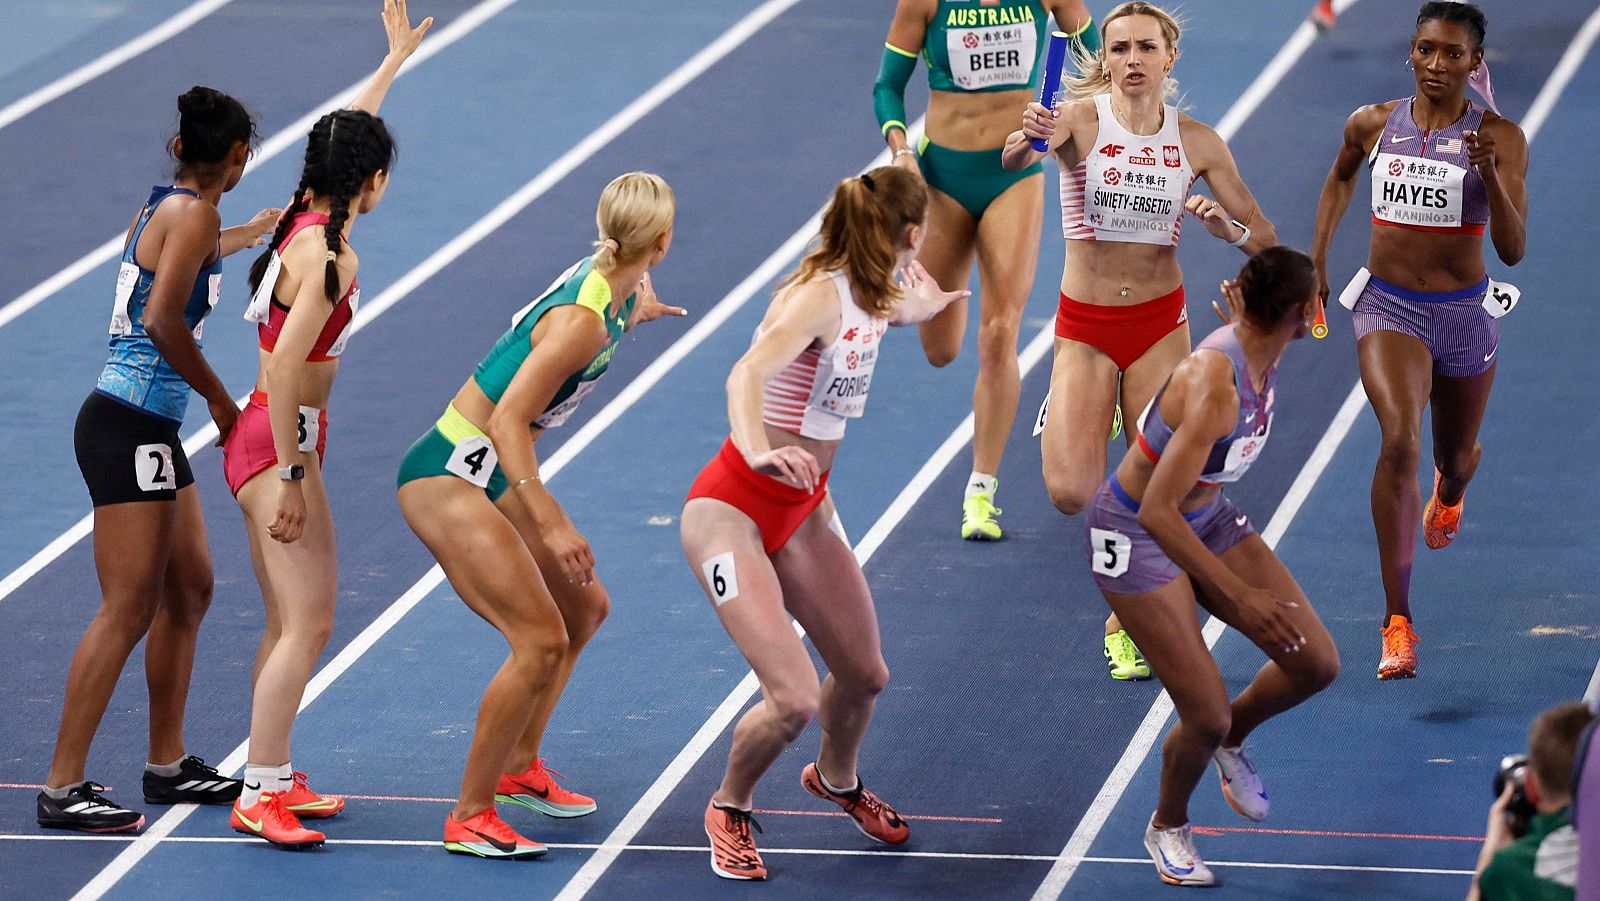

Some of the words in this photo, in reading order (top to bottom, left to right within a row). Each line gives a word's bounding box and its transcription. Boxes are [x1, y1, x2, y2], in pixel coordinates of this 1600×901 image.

[946, 5, 1034, 26] AUSTRALIA
[970, 50, 1019, 71] BEER
[1130, 157, 1155, 165] ORLEN
[1407, 162, 1448, 178] 南京银行
[1124, 171, 1167, 188] 南京银行
[1094, 187, 1172, 215] ŚWIĘTY-ERSETIC
[1383, 181, 1448, 209] HAYES
[1110, 217, 1157, 231] NANJING
[1158, 222, 1169, 232] 25
[1394, 209, 1441, 223] NANJING
[1442, 214, 1456, 223] 25
[1493, 287, 1512, 312] 5
[148, 451, 167, 483] 2
[464, 446, 489, 476] 4
[1104, 538, 1117, 570] 5
[713, 564, 726, 597] 6
